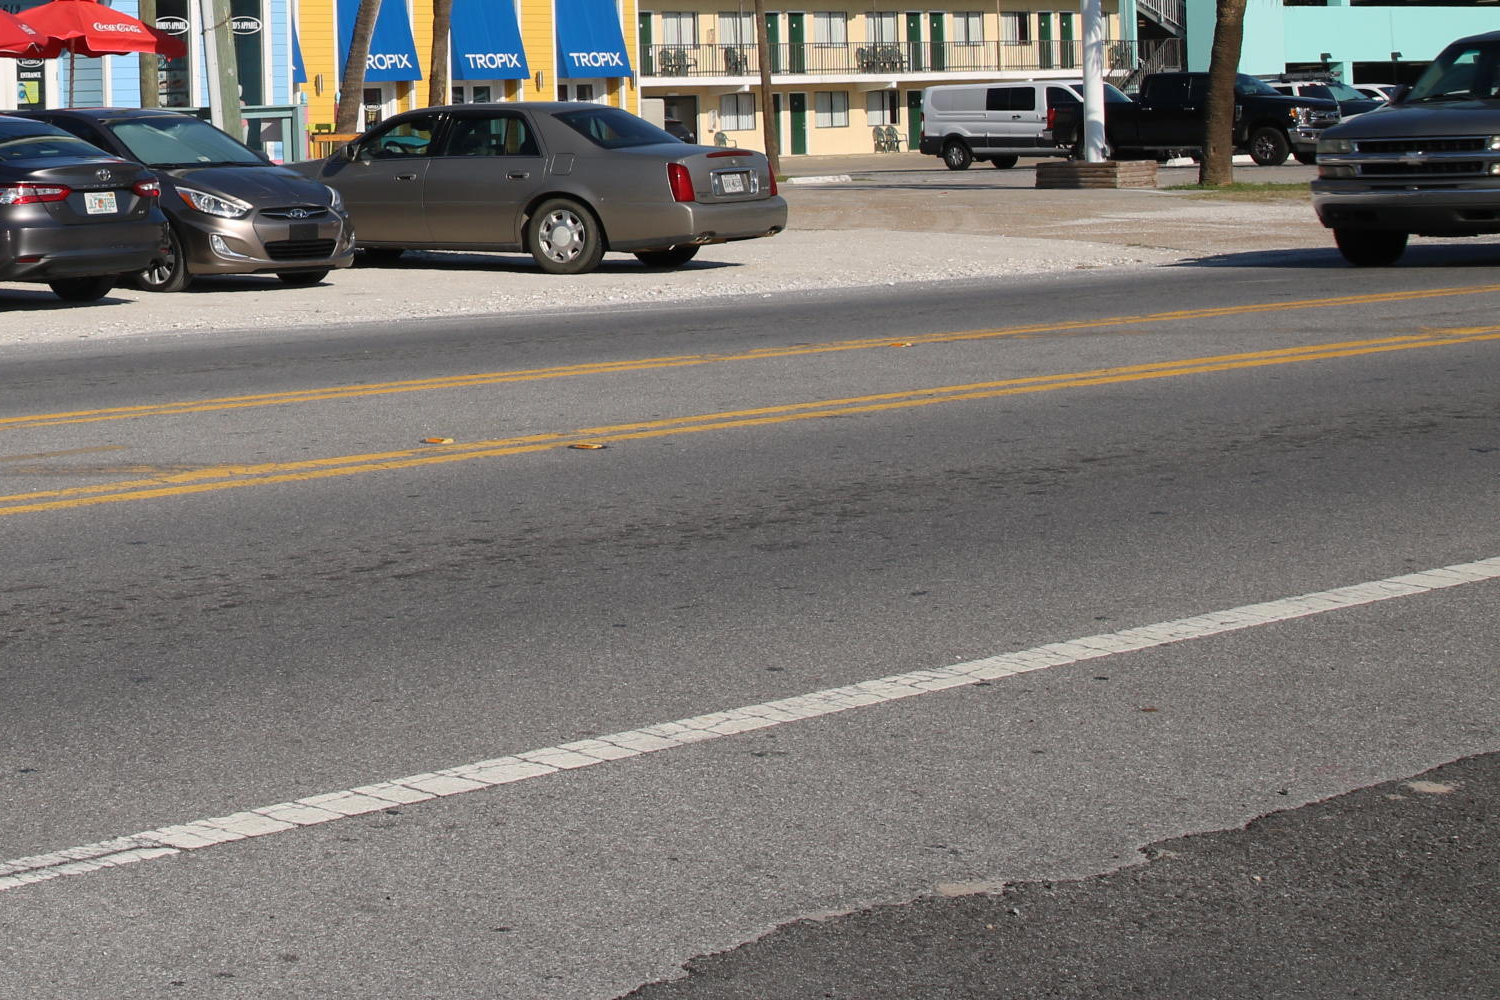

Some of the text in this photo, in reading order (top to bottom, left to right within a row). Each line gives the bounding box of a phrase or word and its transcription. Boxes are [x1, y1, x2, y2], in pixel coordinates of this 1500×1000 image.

[365, 52, 412, 70] ROPIX
[464, 53, 522, 69] TROPIX
[569, 51, 624, 68] TROPIX
